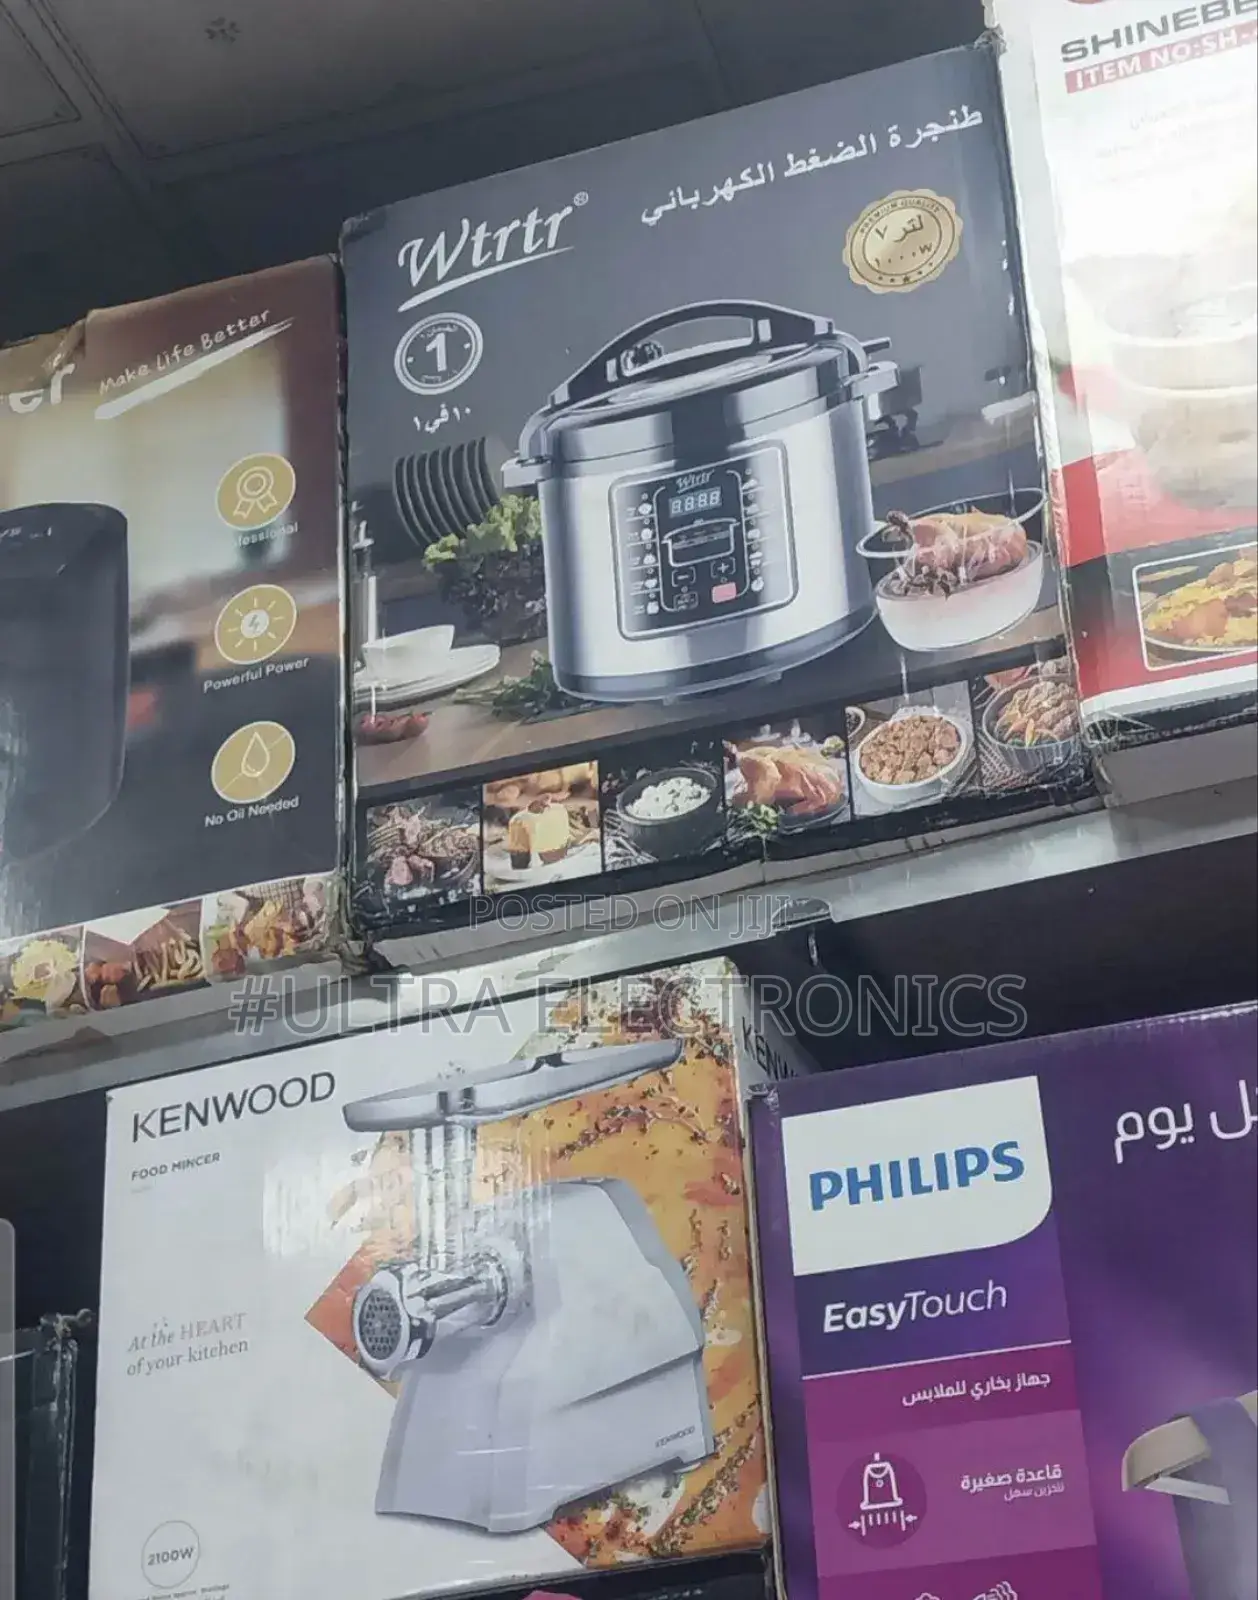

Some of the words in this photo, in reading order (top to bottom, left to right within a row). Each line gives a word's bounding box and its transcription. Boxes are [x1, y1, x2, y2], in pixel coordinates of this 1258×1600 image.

[1076, 58, 1141, 89] ITEM
[888, 105, 983, 148] طنجرة
[784, 133, 877, 177] الضغط
[99, 363, 152, 394] Make
[156, 342, 195, 373] Life
[201, 309, 270, 350] Better
[425, 332, 447, 372] 1
[203, 667, 263, 693] Powerful
[266, 657, 309, 677] Power
[204, 814, 224, 828] No
[226, 807, 245, 822] Oil
[248, 795, 300, 818] Needed
[132, 1071, 336, 1143] KENWOOD
[1114, 1102, 1195, 1164] يوم
[131, 1164, 168, 1180] FOOD
[172, 1152, 221, 1172] MINCER
[809, 1140, 1025, 1211] PHILIPS
[823, 1280, 1008, 1333] EasyTouch
[127, 1335, 149, 1352] At
[150, 1328, 175, 1347] the
[180, 1312, 247, 1340] HEART
[126, 1357, 145, 1376] of
[145, 1354, 184, 1376] your
[188, 1340, 248, 1363] kitchen
[902, 1380, 967, 1406] للملابس
[970, 1375, 1011, 1400] بخاري
[1014, 1372, 1051, 1392] جهاز
[960, 1474, 1012, 1494] صغيرة
[1016, 1464, 1062, 1484] قاعدة
[147, 1547, 194, 1566] 2100W
